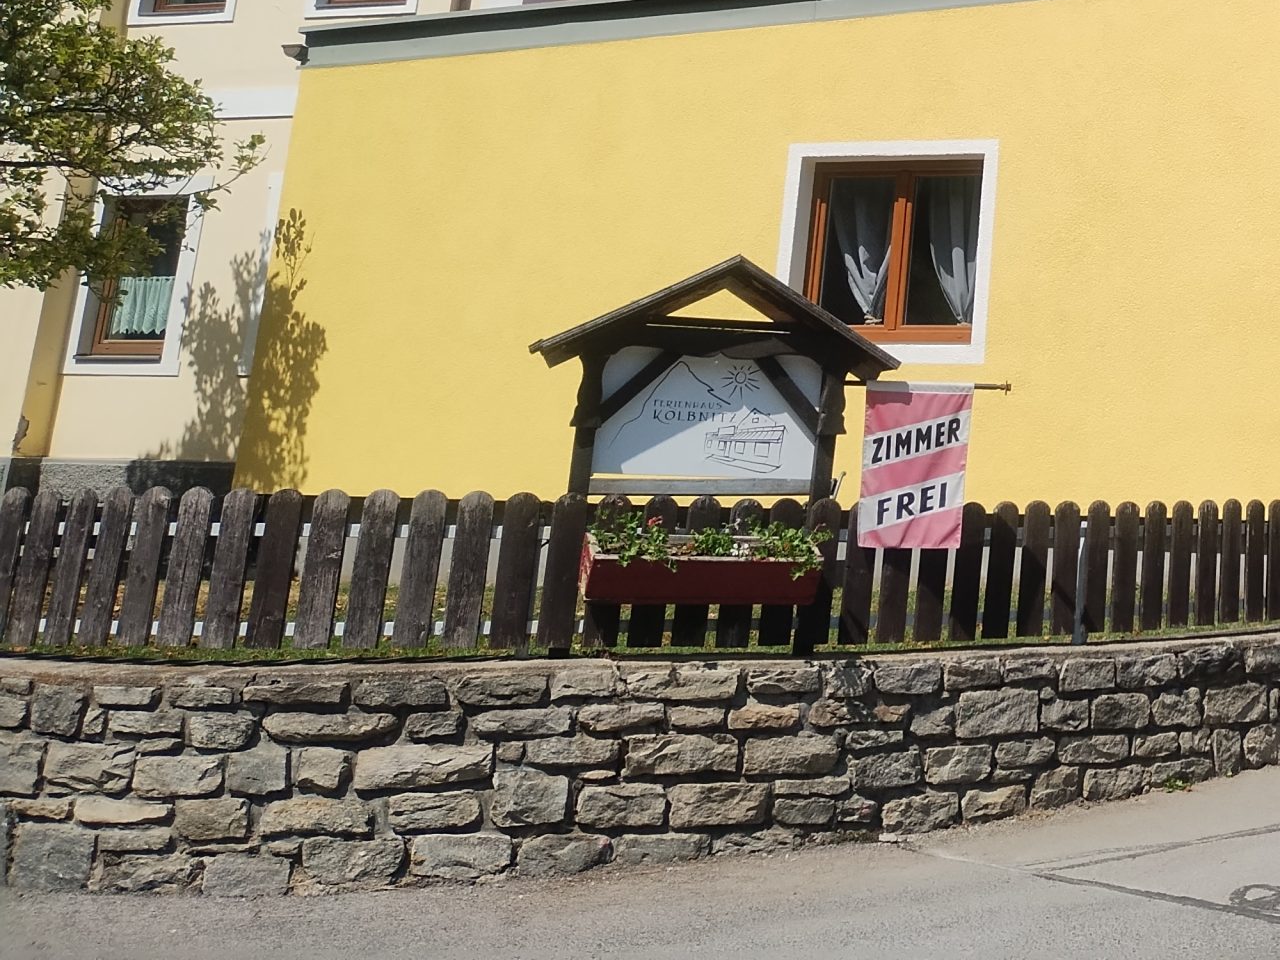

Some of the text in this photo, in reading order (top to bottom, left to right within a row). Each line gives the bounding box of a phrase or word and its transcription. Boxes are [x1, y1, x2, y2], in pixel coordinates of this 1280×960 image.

[653, 399, 723, 410] FERIENHAUS
[871, 417, 961, 465] ZIMMER
[876, 481, 948, 526] FREI
